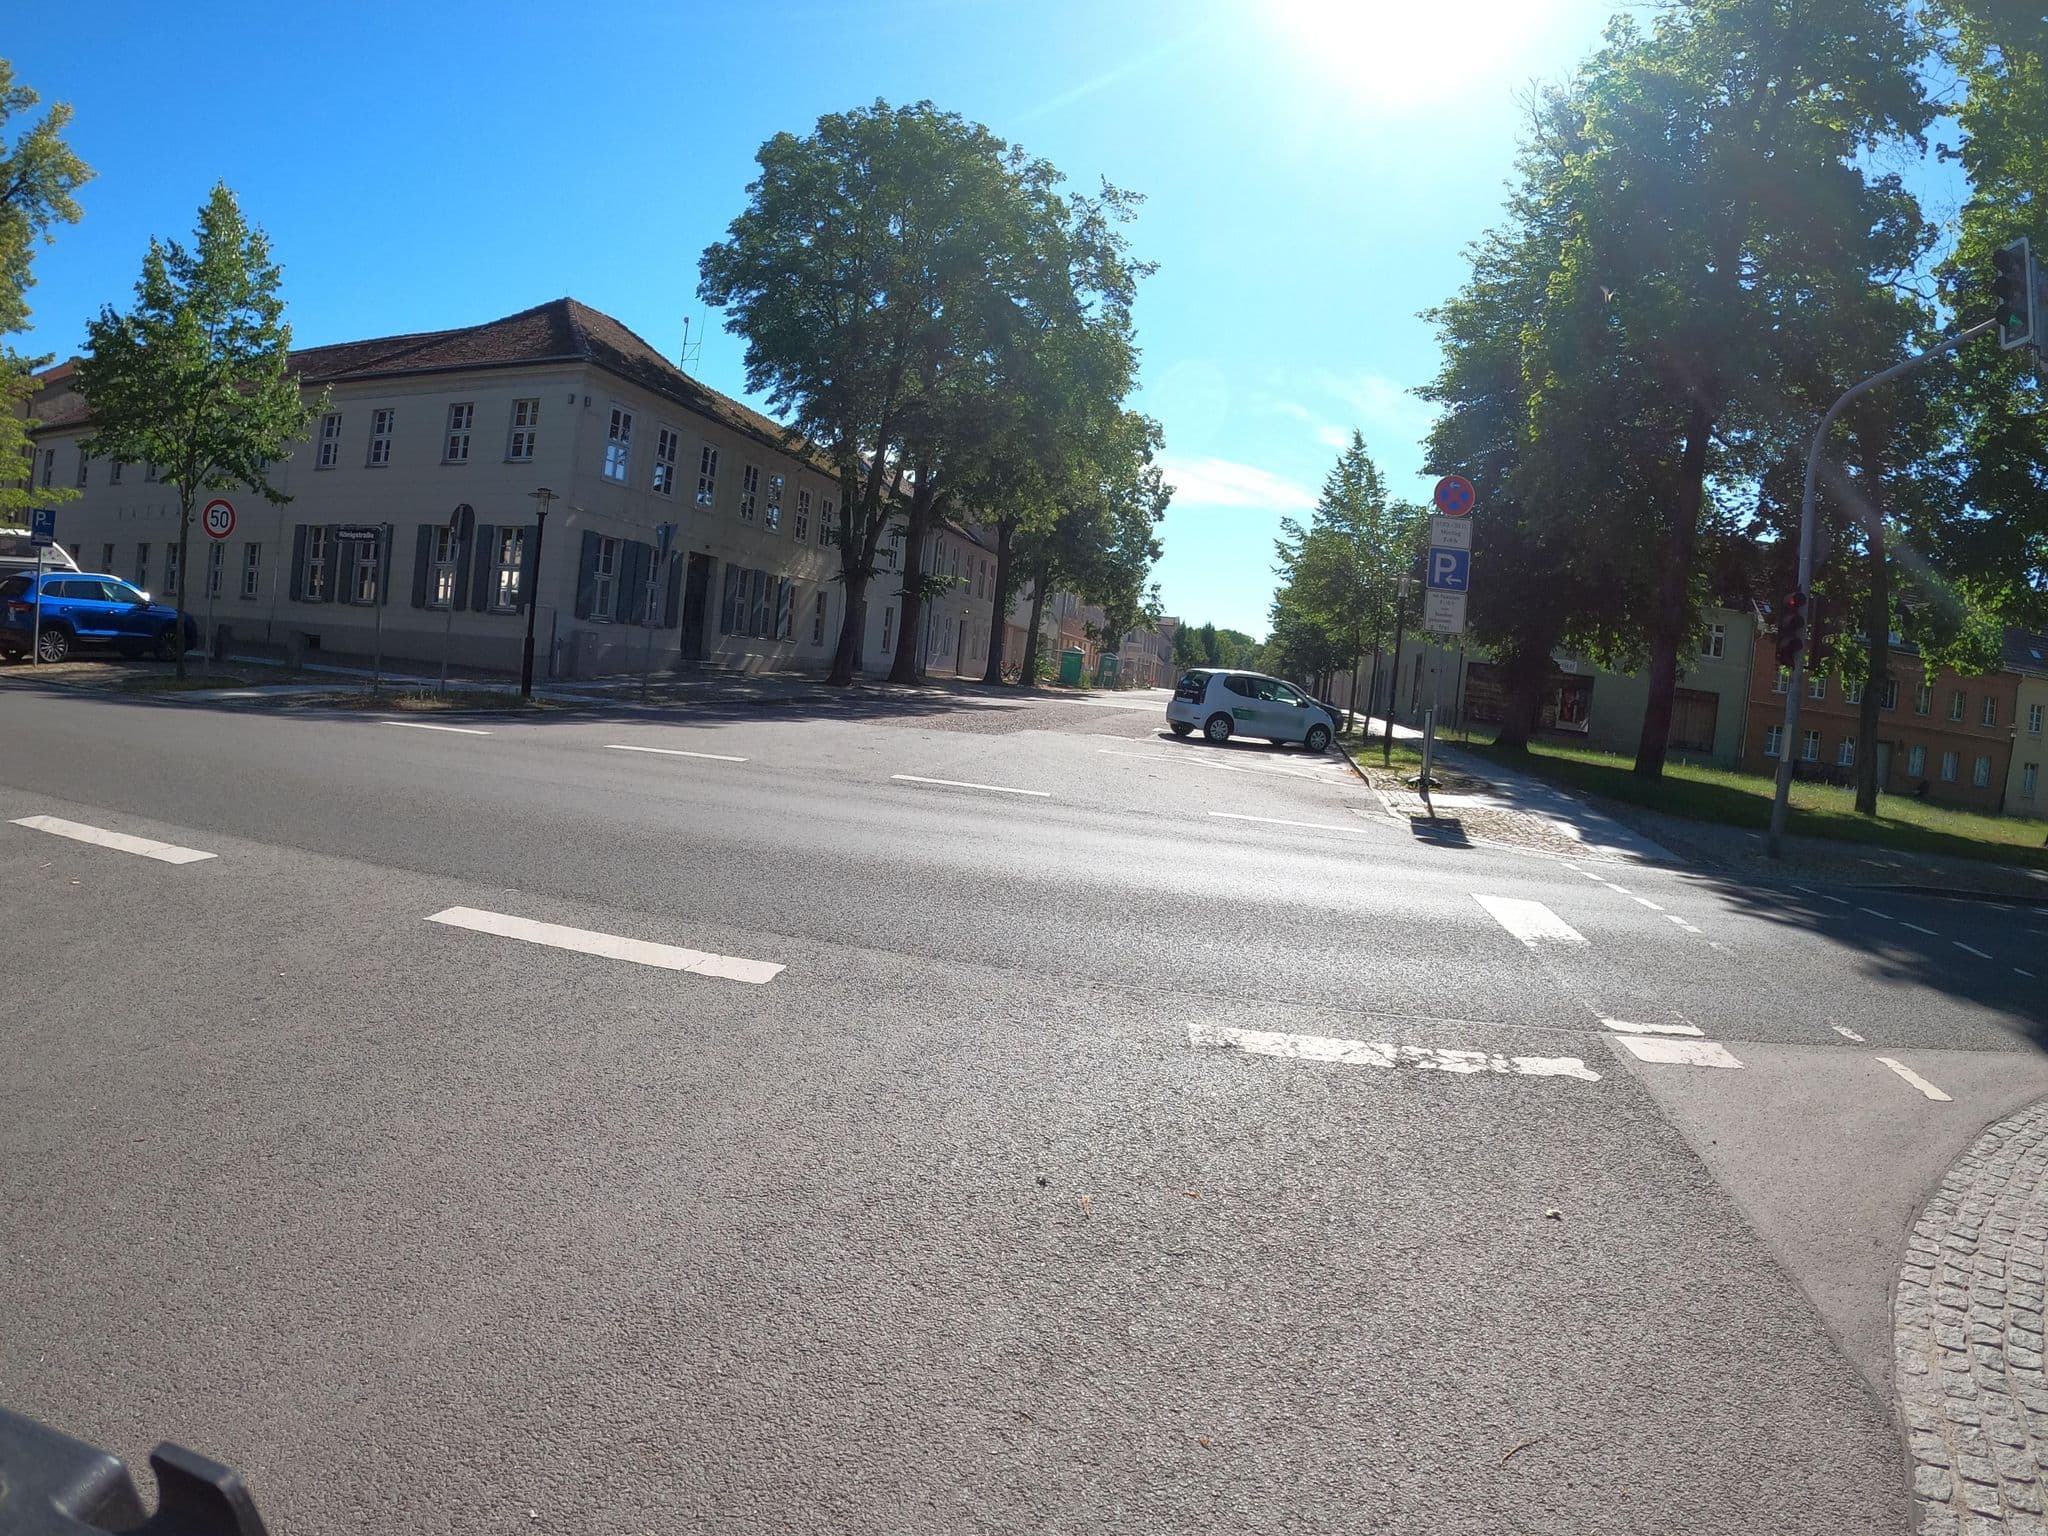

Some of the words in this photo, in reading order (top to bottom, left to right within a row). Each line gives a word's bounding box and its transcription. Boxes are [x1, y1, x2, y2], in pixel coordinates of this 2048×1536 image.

[36, 511, 46, 526] P
[210, 509, 229, 528] 50
[1434, 553, 1456, 584] P
